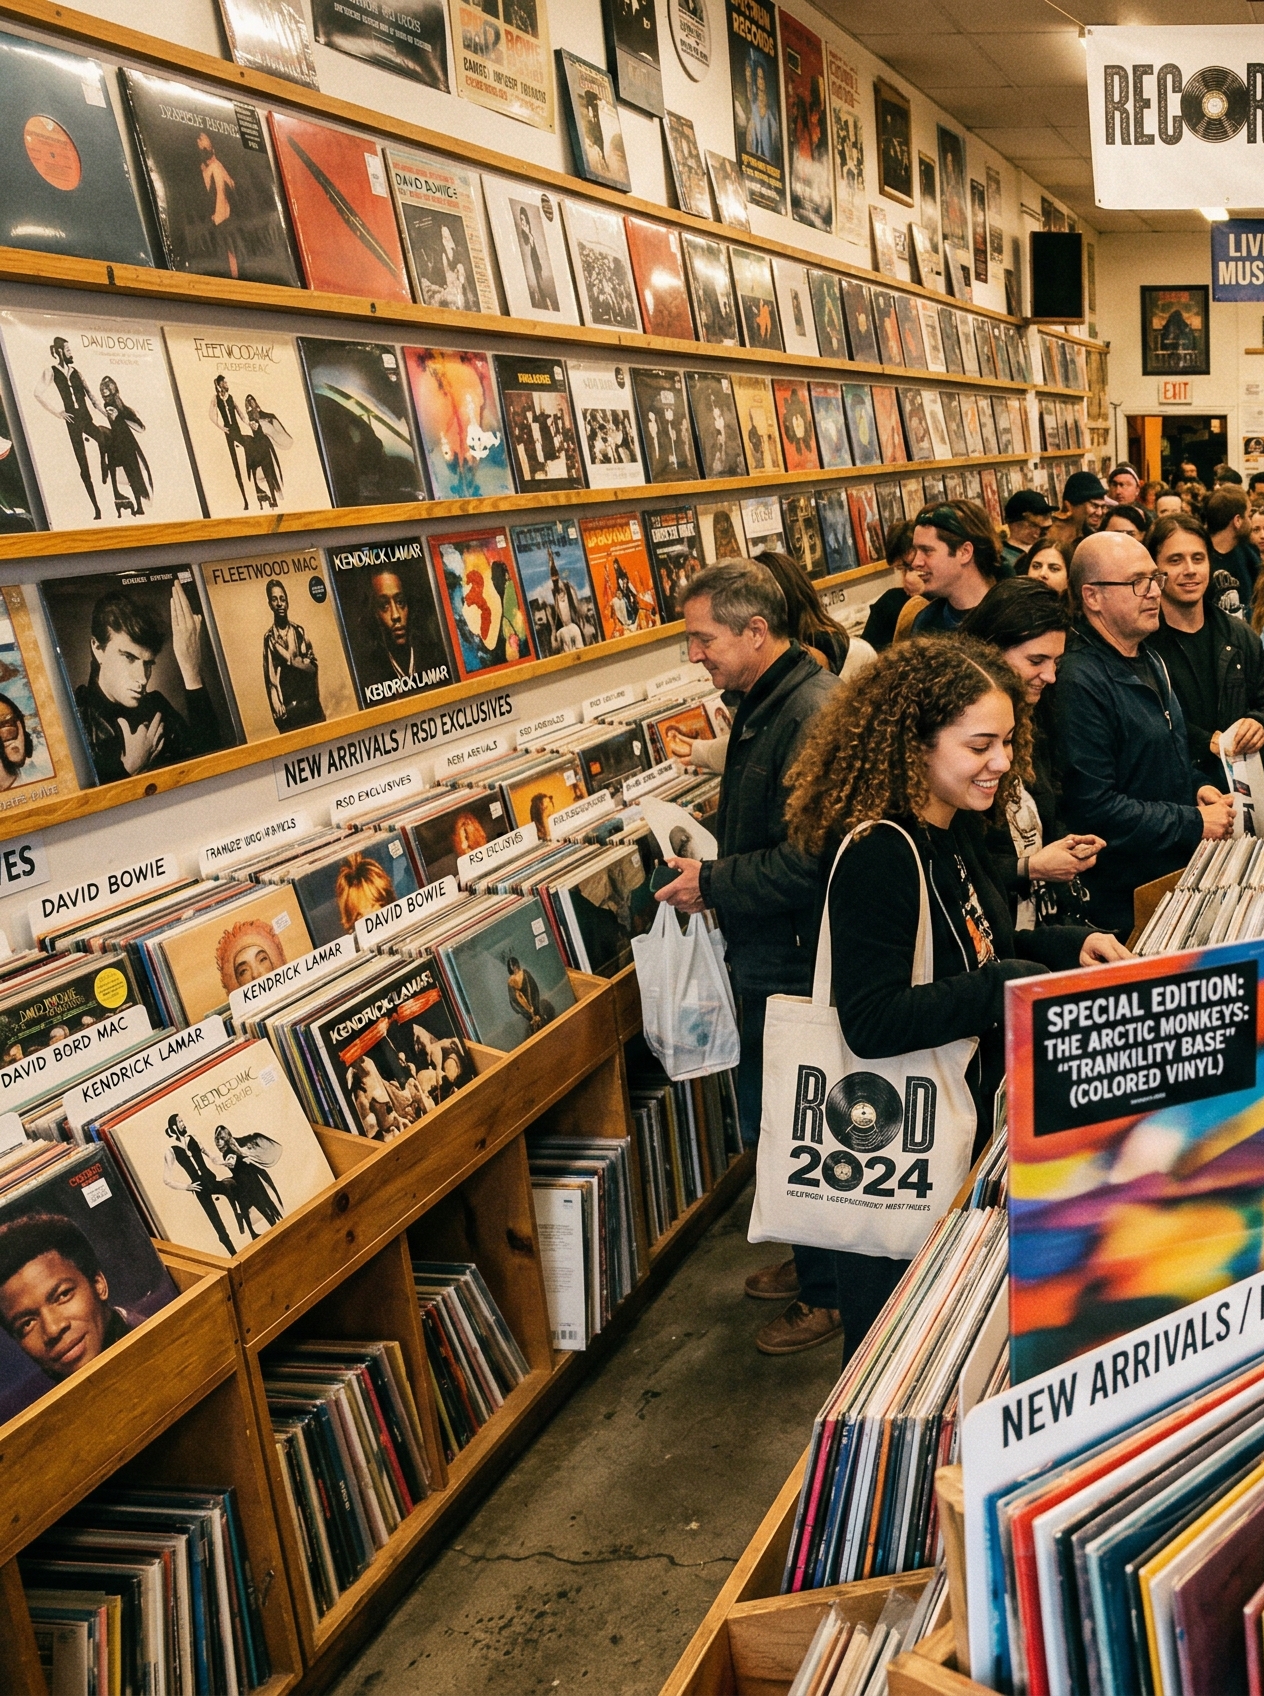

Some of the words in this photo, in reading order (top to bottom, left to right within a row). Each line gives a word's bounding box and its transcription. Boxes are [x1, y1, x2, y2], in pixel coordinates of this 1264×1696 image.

[81, 334, 116, 349] DAVID
[1163, 381, 1189, 400] EXIT
[212, 564, 290, 585] FLEETWOOD
[293, 556, 318, 572] MAC
[389, 543, 422, 562] LAMAR
[414, 665, 449, 690] LAMAR
[283, 755, 322, 787] NEW
[327, 728, 399, 774] ARRIVALS
[411, 717, 437, 745] RSD
[441, 693, 513, 736] EXCLUSIVES
[0, 845, 36, 885] ES
[41, 881, 100, 919] DAVID
[107, 857, 166, 895] BOWIE
[364, 902, 403, 934] DAVID
[406, 881, 446, 914] BOWIE
[242, 962, 302, 1004] KENDRICK
[305, 943, 342, 972] LAMAR
[1047, 992, 1145, 1033] SPECIAL
[1151, 973, 1245, 1014] EDITION:
[0, 1056, 47, 1089] DAVID
[53, 1034, 92, 1062] BORD
[96, 1016, 129, 1042] MAC
[1043, 1034, 1083, 1061] THE
[1087, 1019, 1155, 1053] ARCTIC
[1159, 1002, 1250, 1037] MONKEYS:
[82, 1054, 154, 1103] KENDRICK
[158, 1027, 205, 1062] LAMAR
[1069, 1068, 1161, 1108] (COLORED
[1165, 1053, 1224, 1084] VINYL)
[787, 1144, 933, 1199] 2024
[1002, 1371, 1079, 1449] NEW
[1089, 1301, 1231, 1406] ARRIVALS
[1239, 1287, 1252, 1335] /
